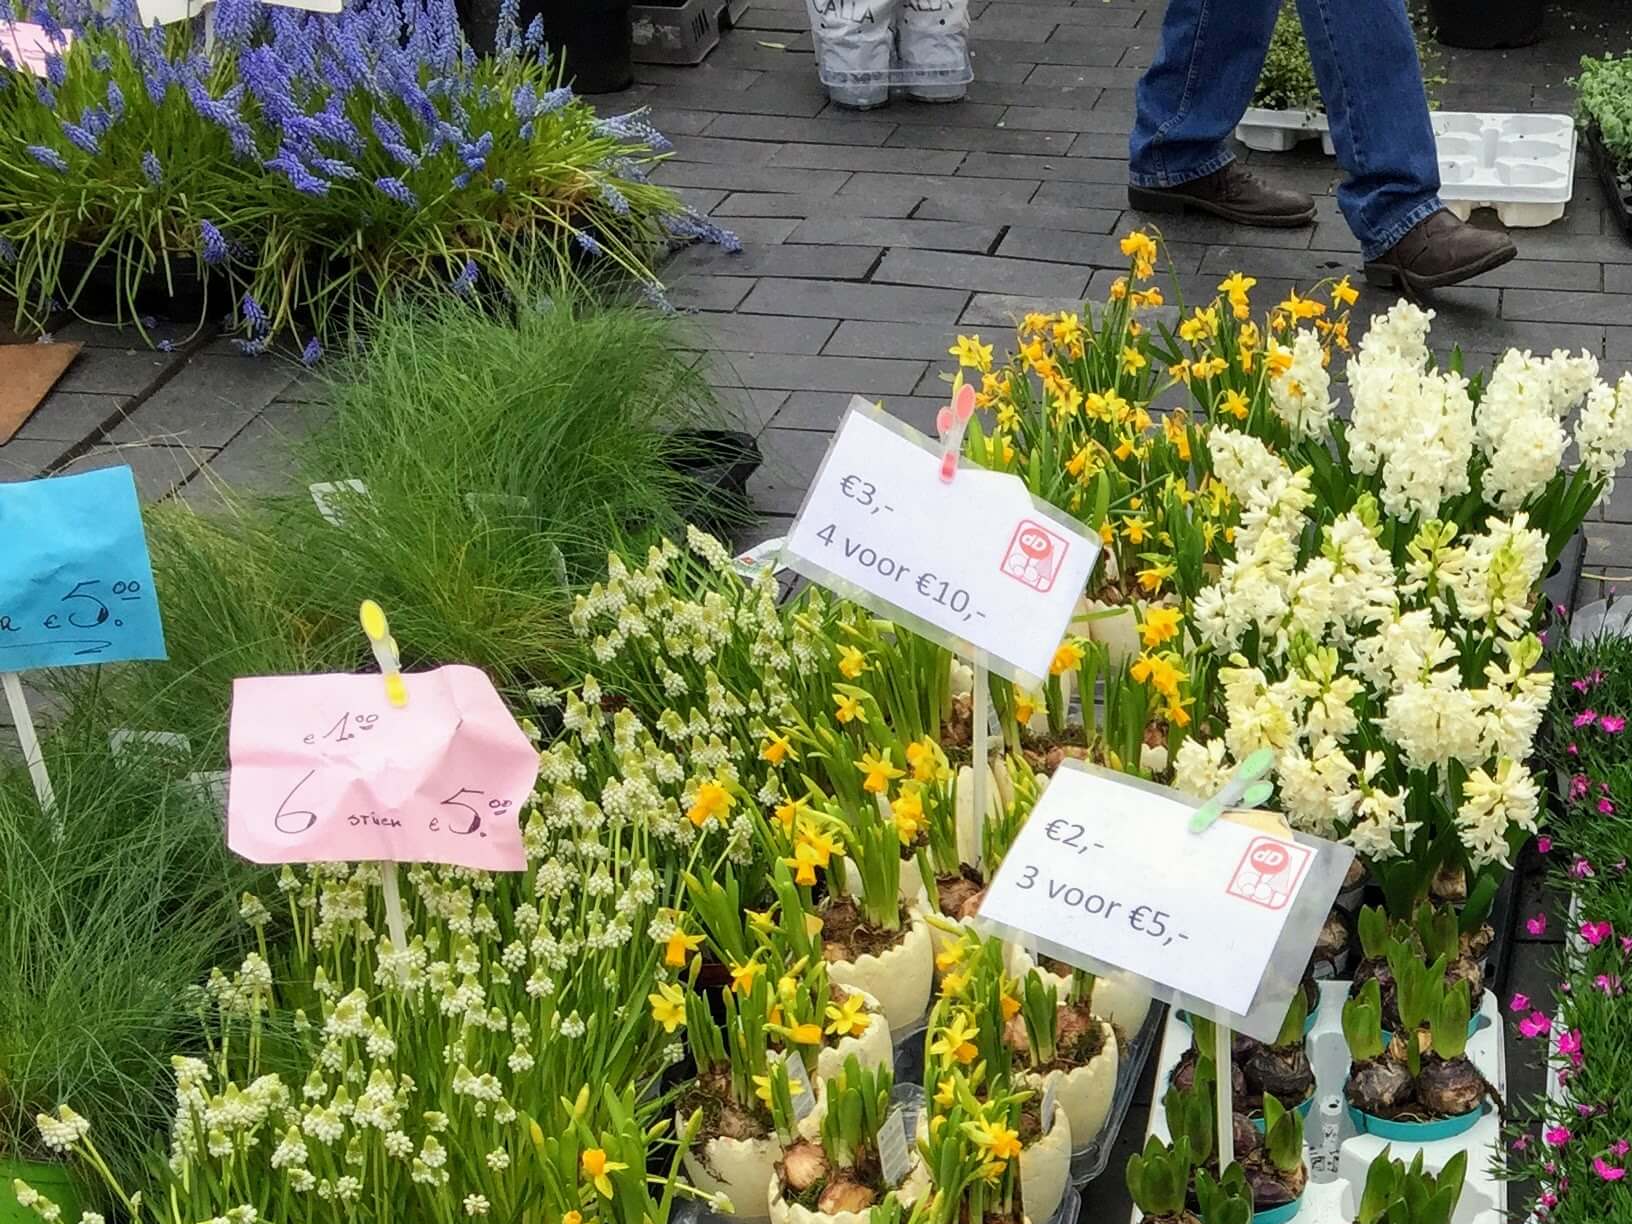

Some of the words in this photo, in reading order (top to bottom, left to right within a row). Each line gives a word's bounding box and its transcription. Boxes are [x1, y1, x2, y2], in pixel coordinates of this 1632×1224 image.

[816, 523, 837, 548] 4
[844, 537, 911, 582] voor
[915, 572, 986, 622] €10,-
[275, 769, 317, 833] 6
[1016, 865, 1039, 890] 3
[1047, 878, 1122, 919] voor
[1128, 905, 1189, 946] €5,-
